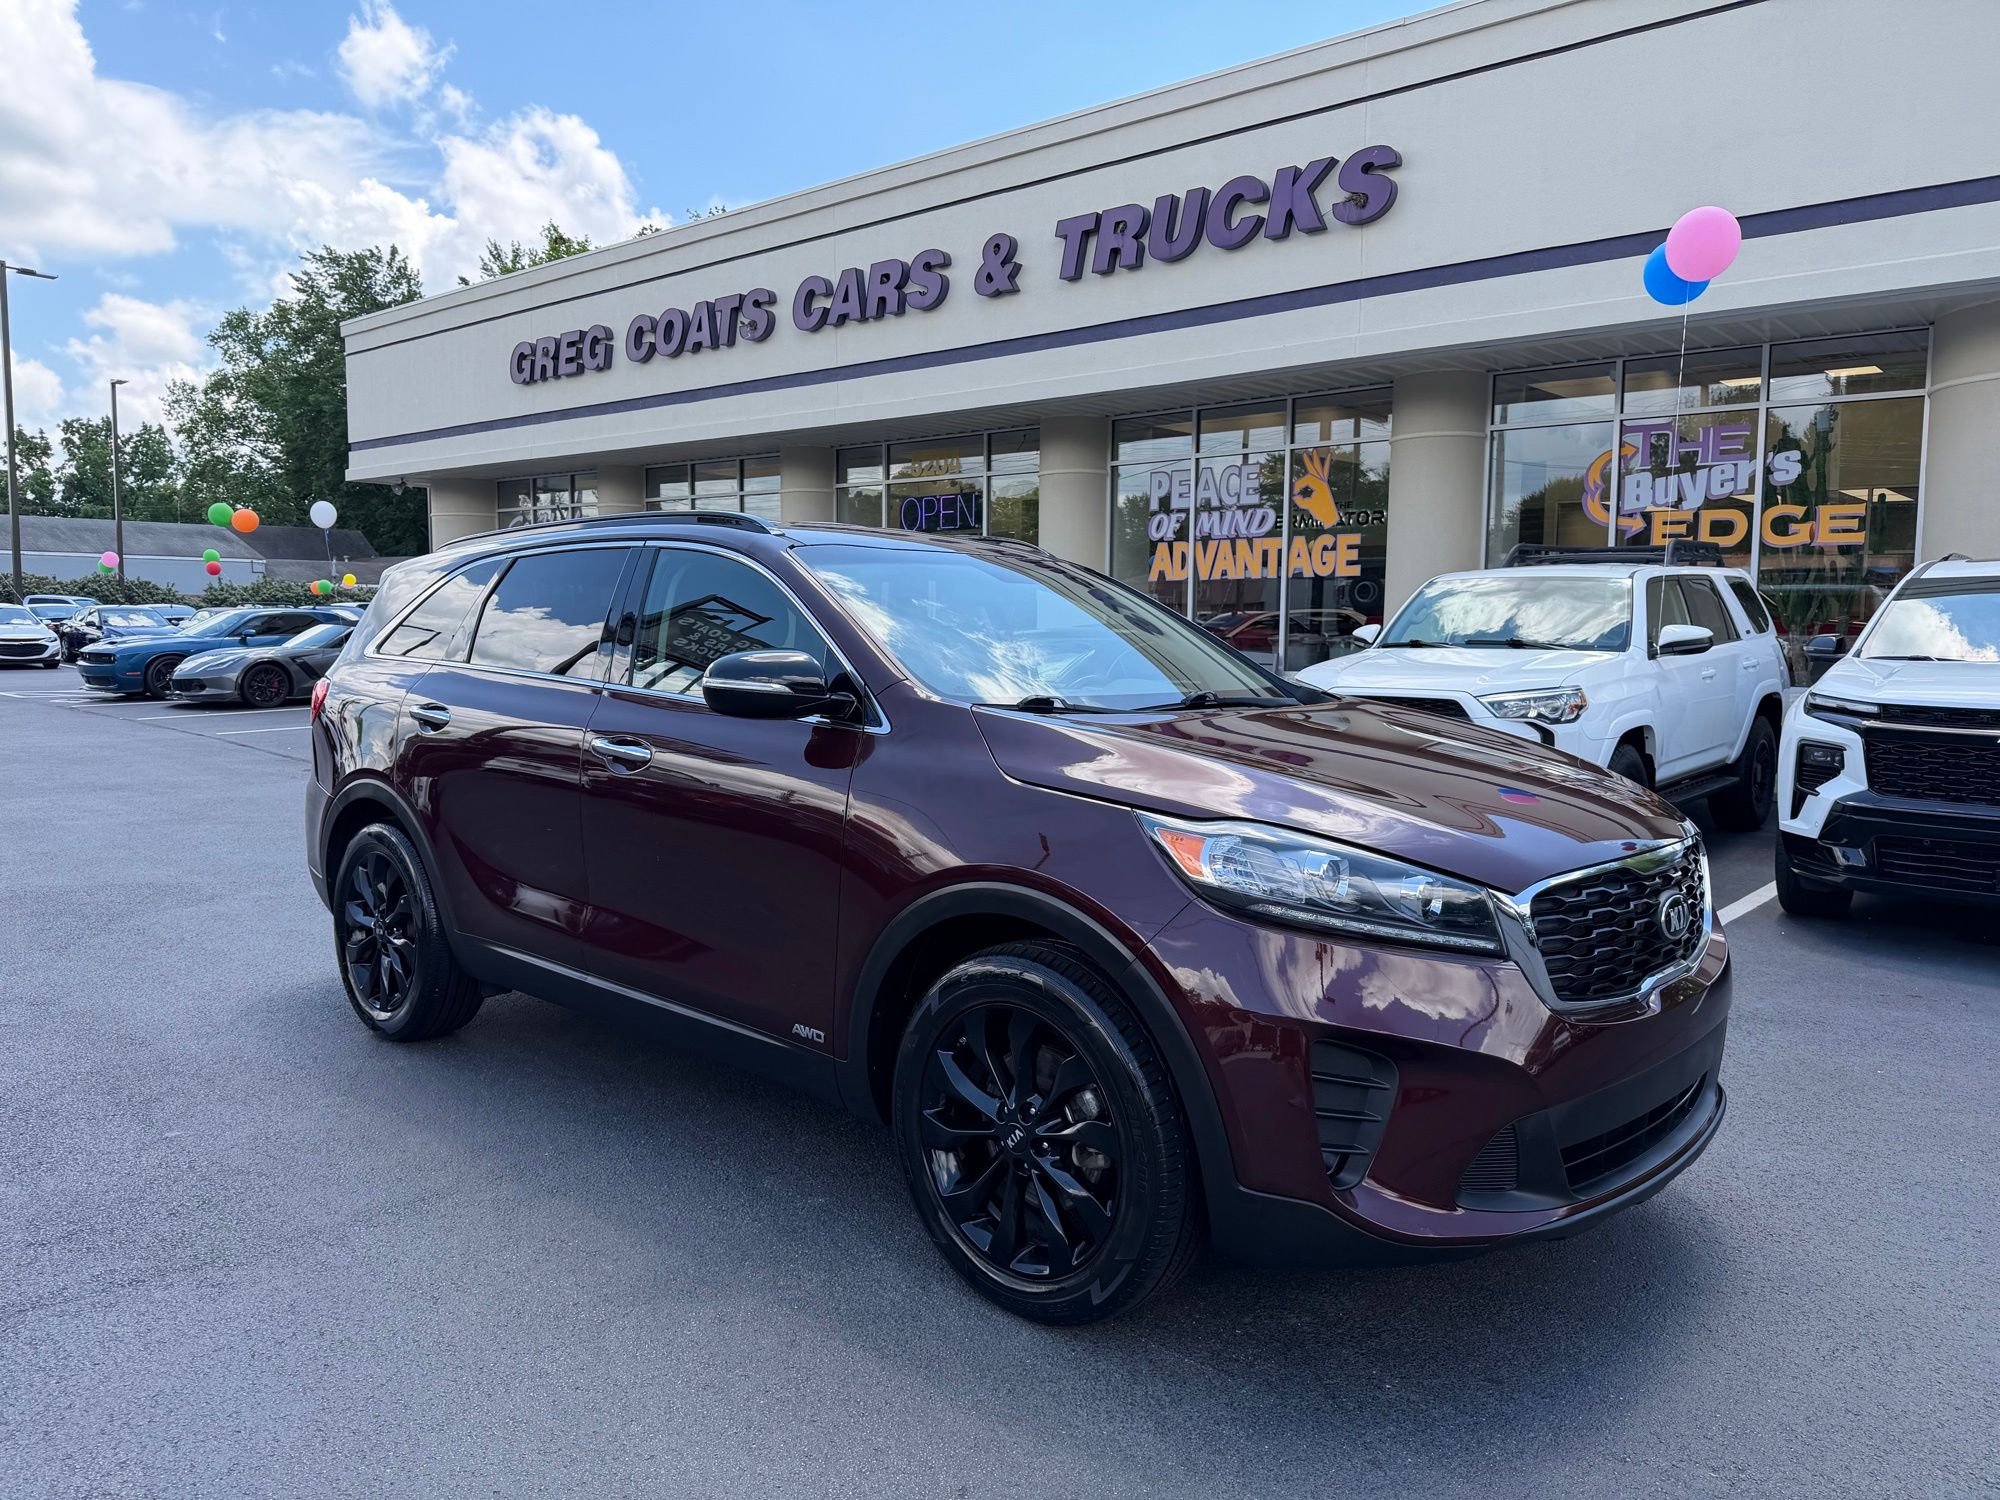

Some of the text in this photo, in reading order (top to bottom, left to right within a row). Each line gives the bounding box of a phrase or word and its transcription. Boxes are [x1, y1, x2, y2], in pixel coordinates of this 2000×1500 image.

[510, 144, 1403, 385] GREG COATS CARS & TRUCKS
[1622, 421, 1751, 468] THE
[1150, 463, 1260, 511] PEACE
[1619, 449, 1802, 515] Buyer's
[901, 493, 976, 532] OPEN
[1148, 507, 1277, 541] OF MIND
[1650, 502, 1867, 549] EDGE
[1148, 532, 1362, 582] ADVANTAGE
[791, 1023, 826, 1043] AWD
[1006, 1129, 1024, 1149] KIA
